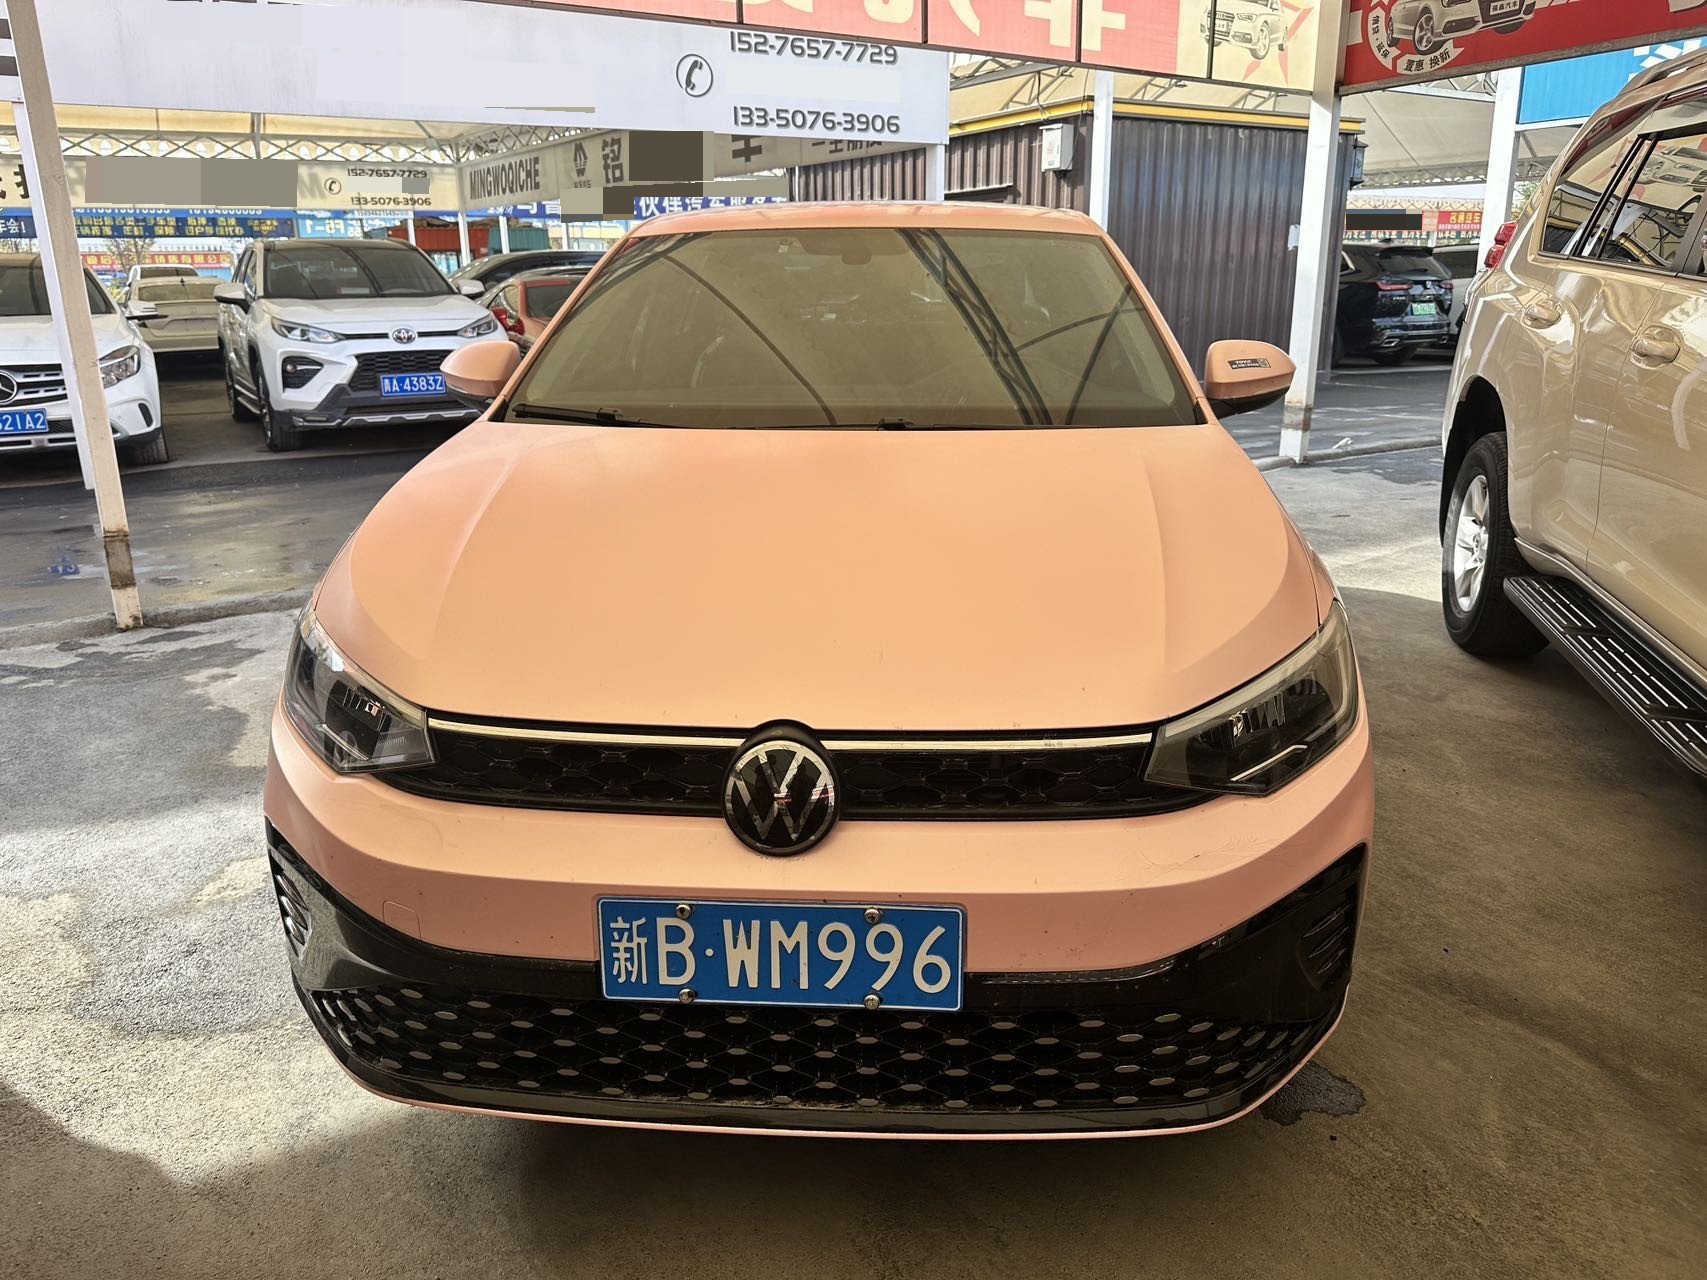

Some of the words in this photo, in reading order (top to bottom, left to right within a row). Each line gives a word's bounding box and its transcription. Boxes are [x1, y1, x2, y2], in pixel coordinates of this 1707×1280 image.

[730, 31, 899, 64] 152-7657-7729
[733, 105, 901, 134] 133-5076-3906
[347, 167, 428, 178] 152-7657-7729
[469, 156, 541, 200] MINGWOQICHE
[350, 196, 432, 206] 133-5076-3906
[610, 916, 951, 994] 新B·WM996
